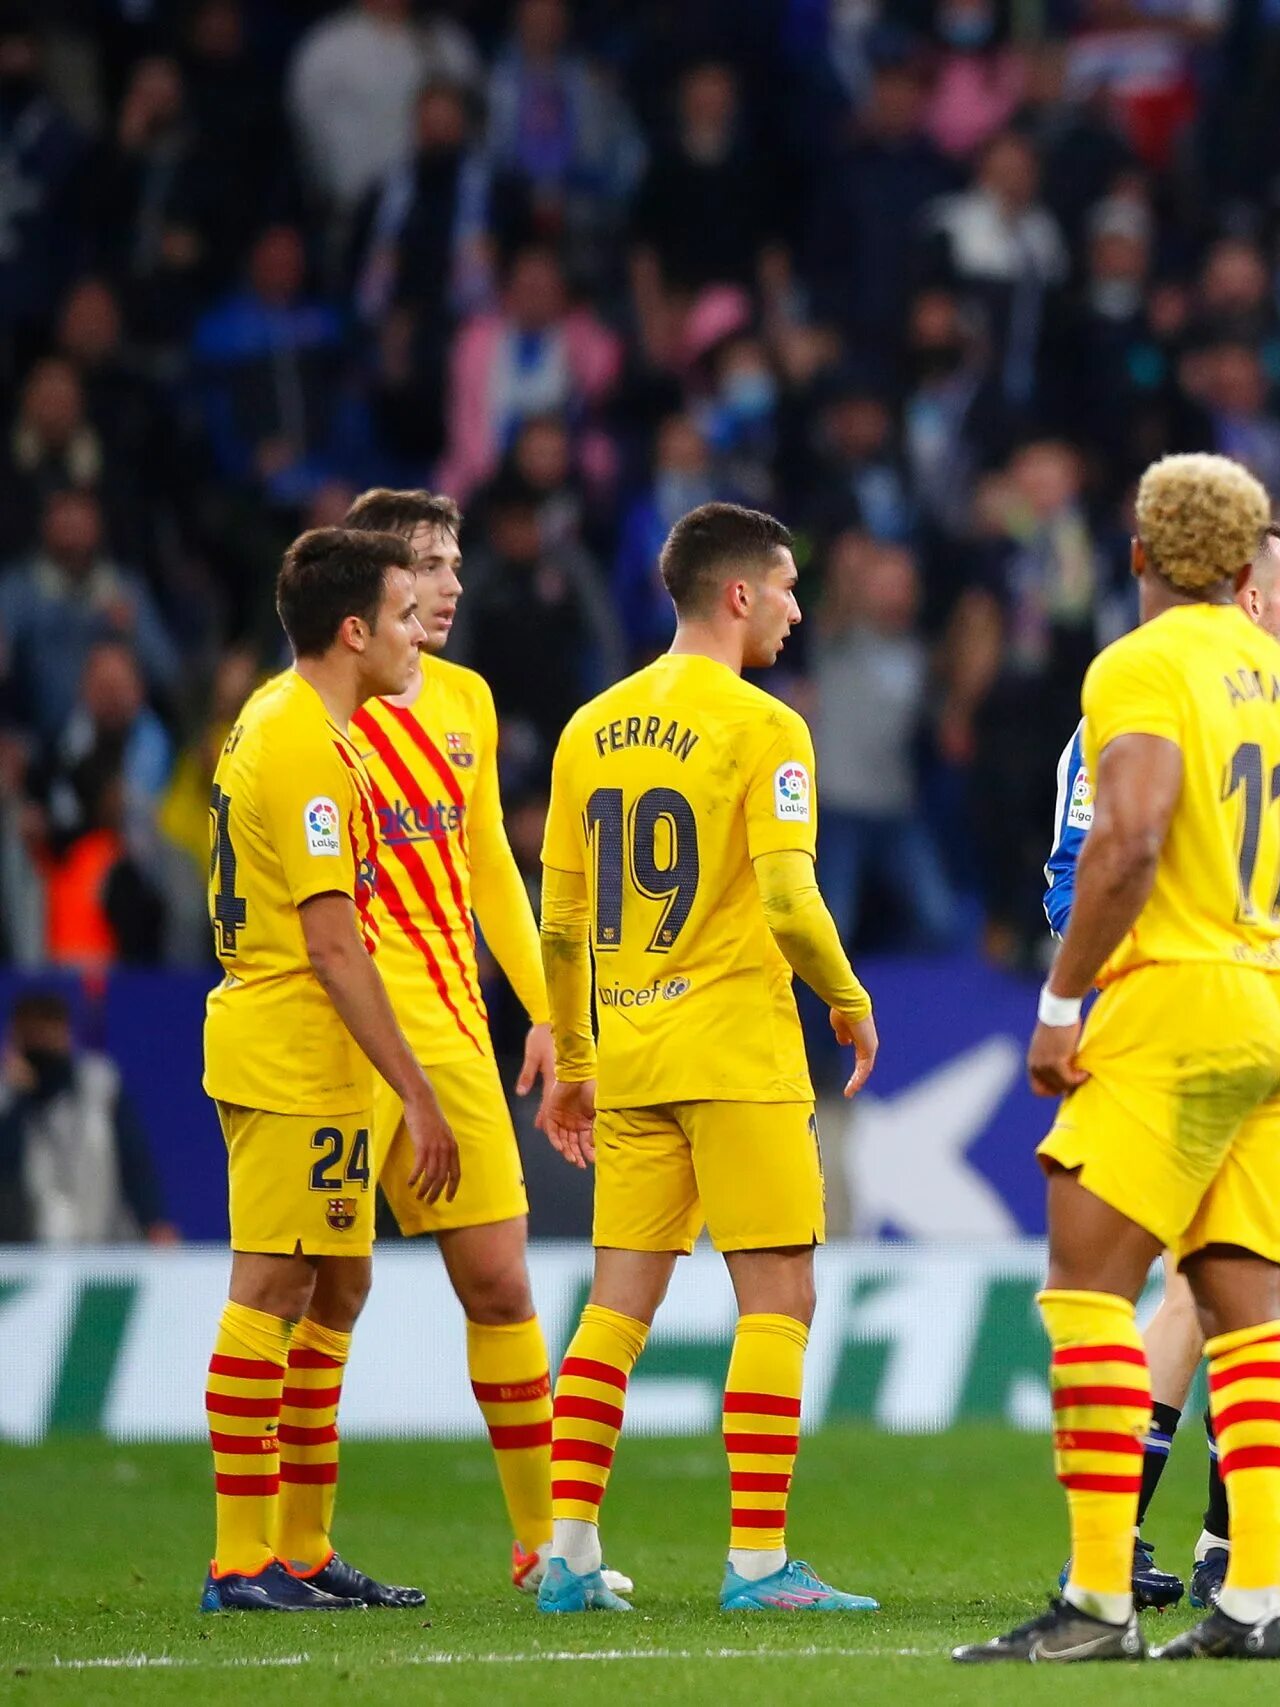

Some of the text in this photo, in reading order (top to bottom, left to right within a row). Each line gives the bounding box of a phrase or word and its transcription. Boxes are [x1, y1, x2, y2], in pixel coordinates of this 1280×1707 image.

[594, 715, 699, 763] FERRAN
[780, 804, 808, 815] LaLiga
[312, 838, 339, 849] LaLiga
[582, 787, 700, 953] 19
[598, 979, 661, 1008] unicef
[309, 1126, 370, 1192] 24
